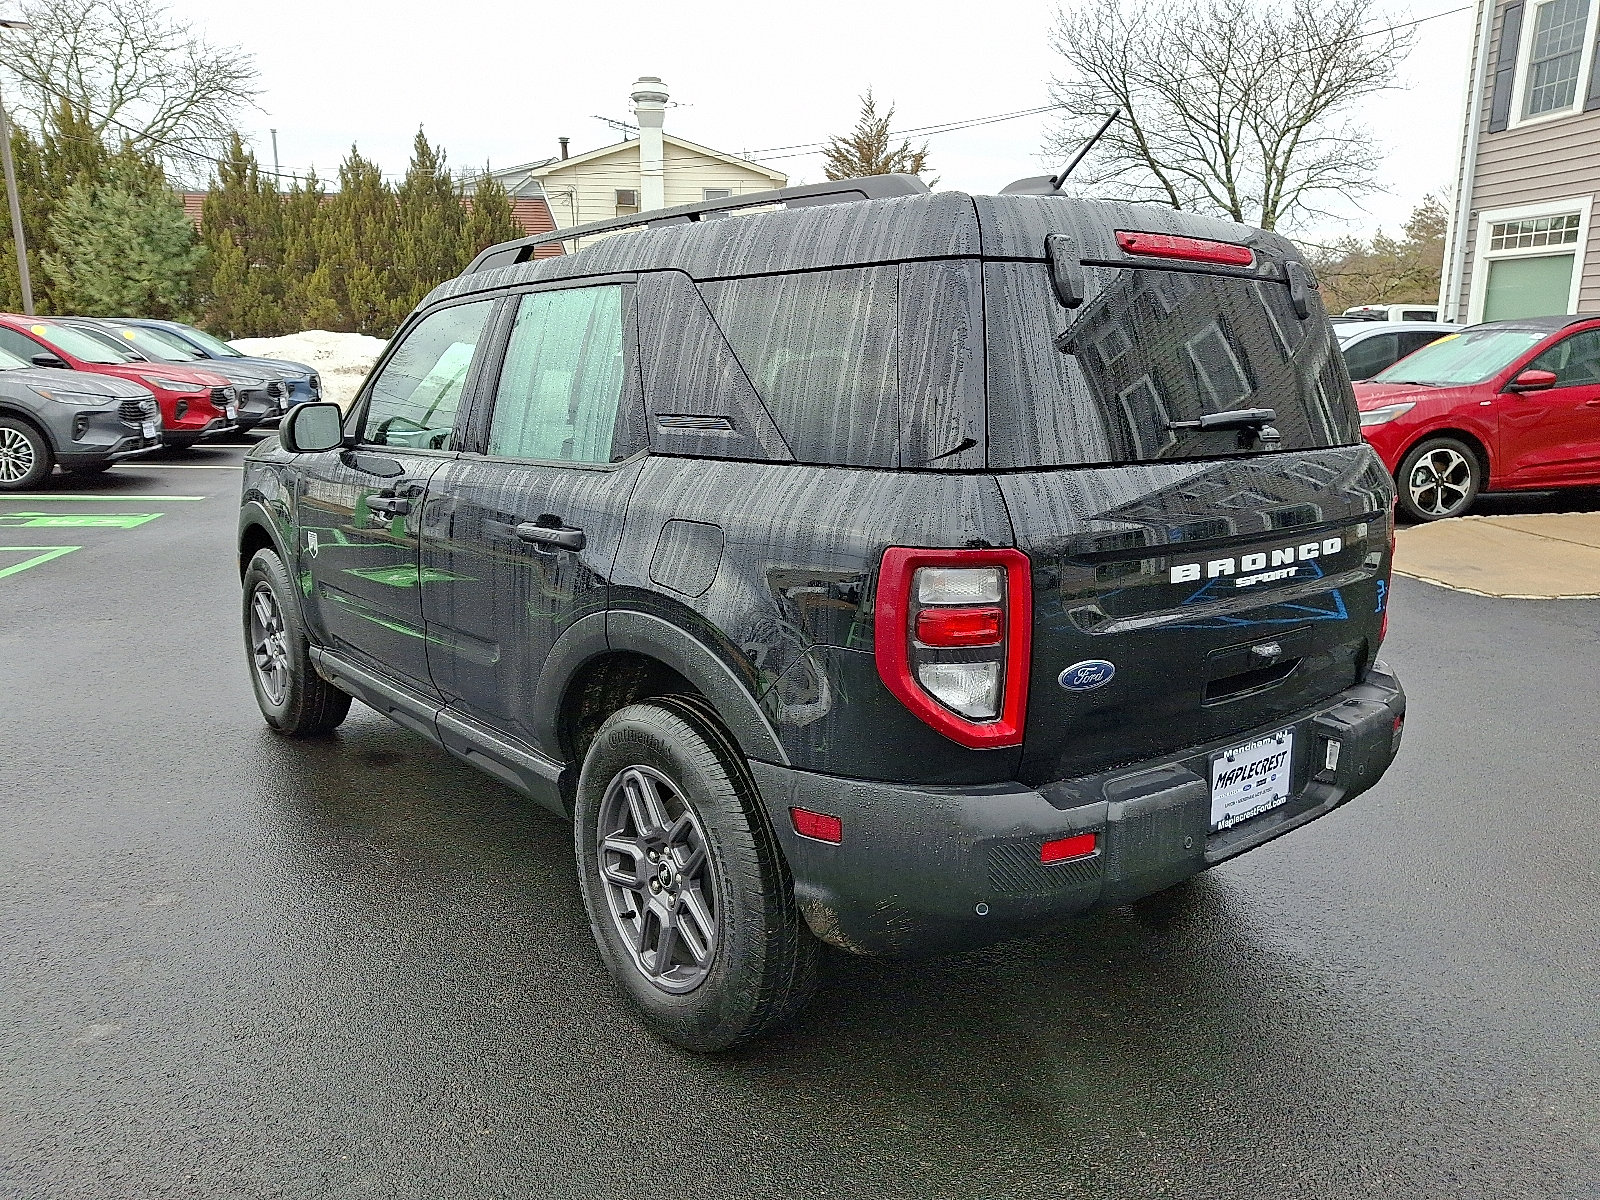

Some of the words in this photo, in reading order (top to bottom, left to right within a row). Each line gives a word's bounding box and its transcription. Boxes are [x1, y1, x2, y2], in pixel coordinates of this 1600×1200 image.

[1170, 537, 1342, 584] BRONCO
[1235, 566, 1299, 588] SPORT
[1073, 666, 1105, 685] Ford
[1275, 730, 1288, 741] NJ
[1214, 750, 1288, 791] MAPLECREST
[1217, 796, 1287, 830] MaplecrestFord.com
